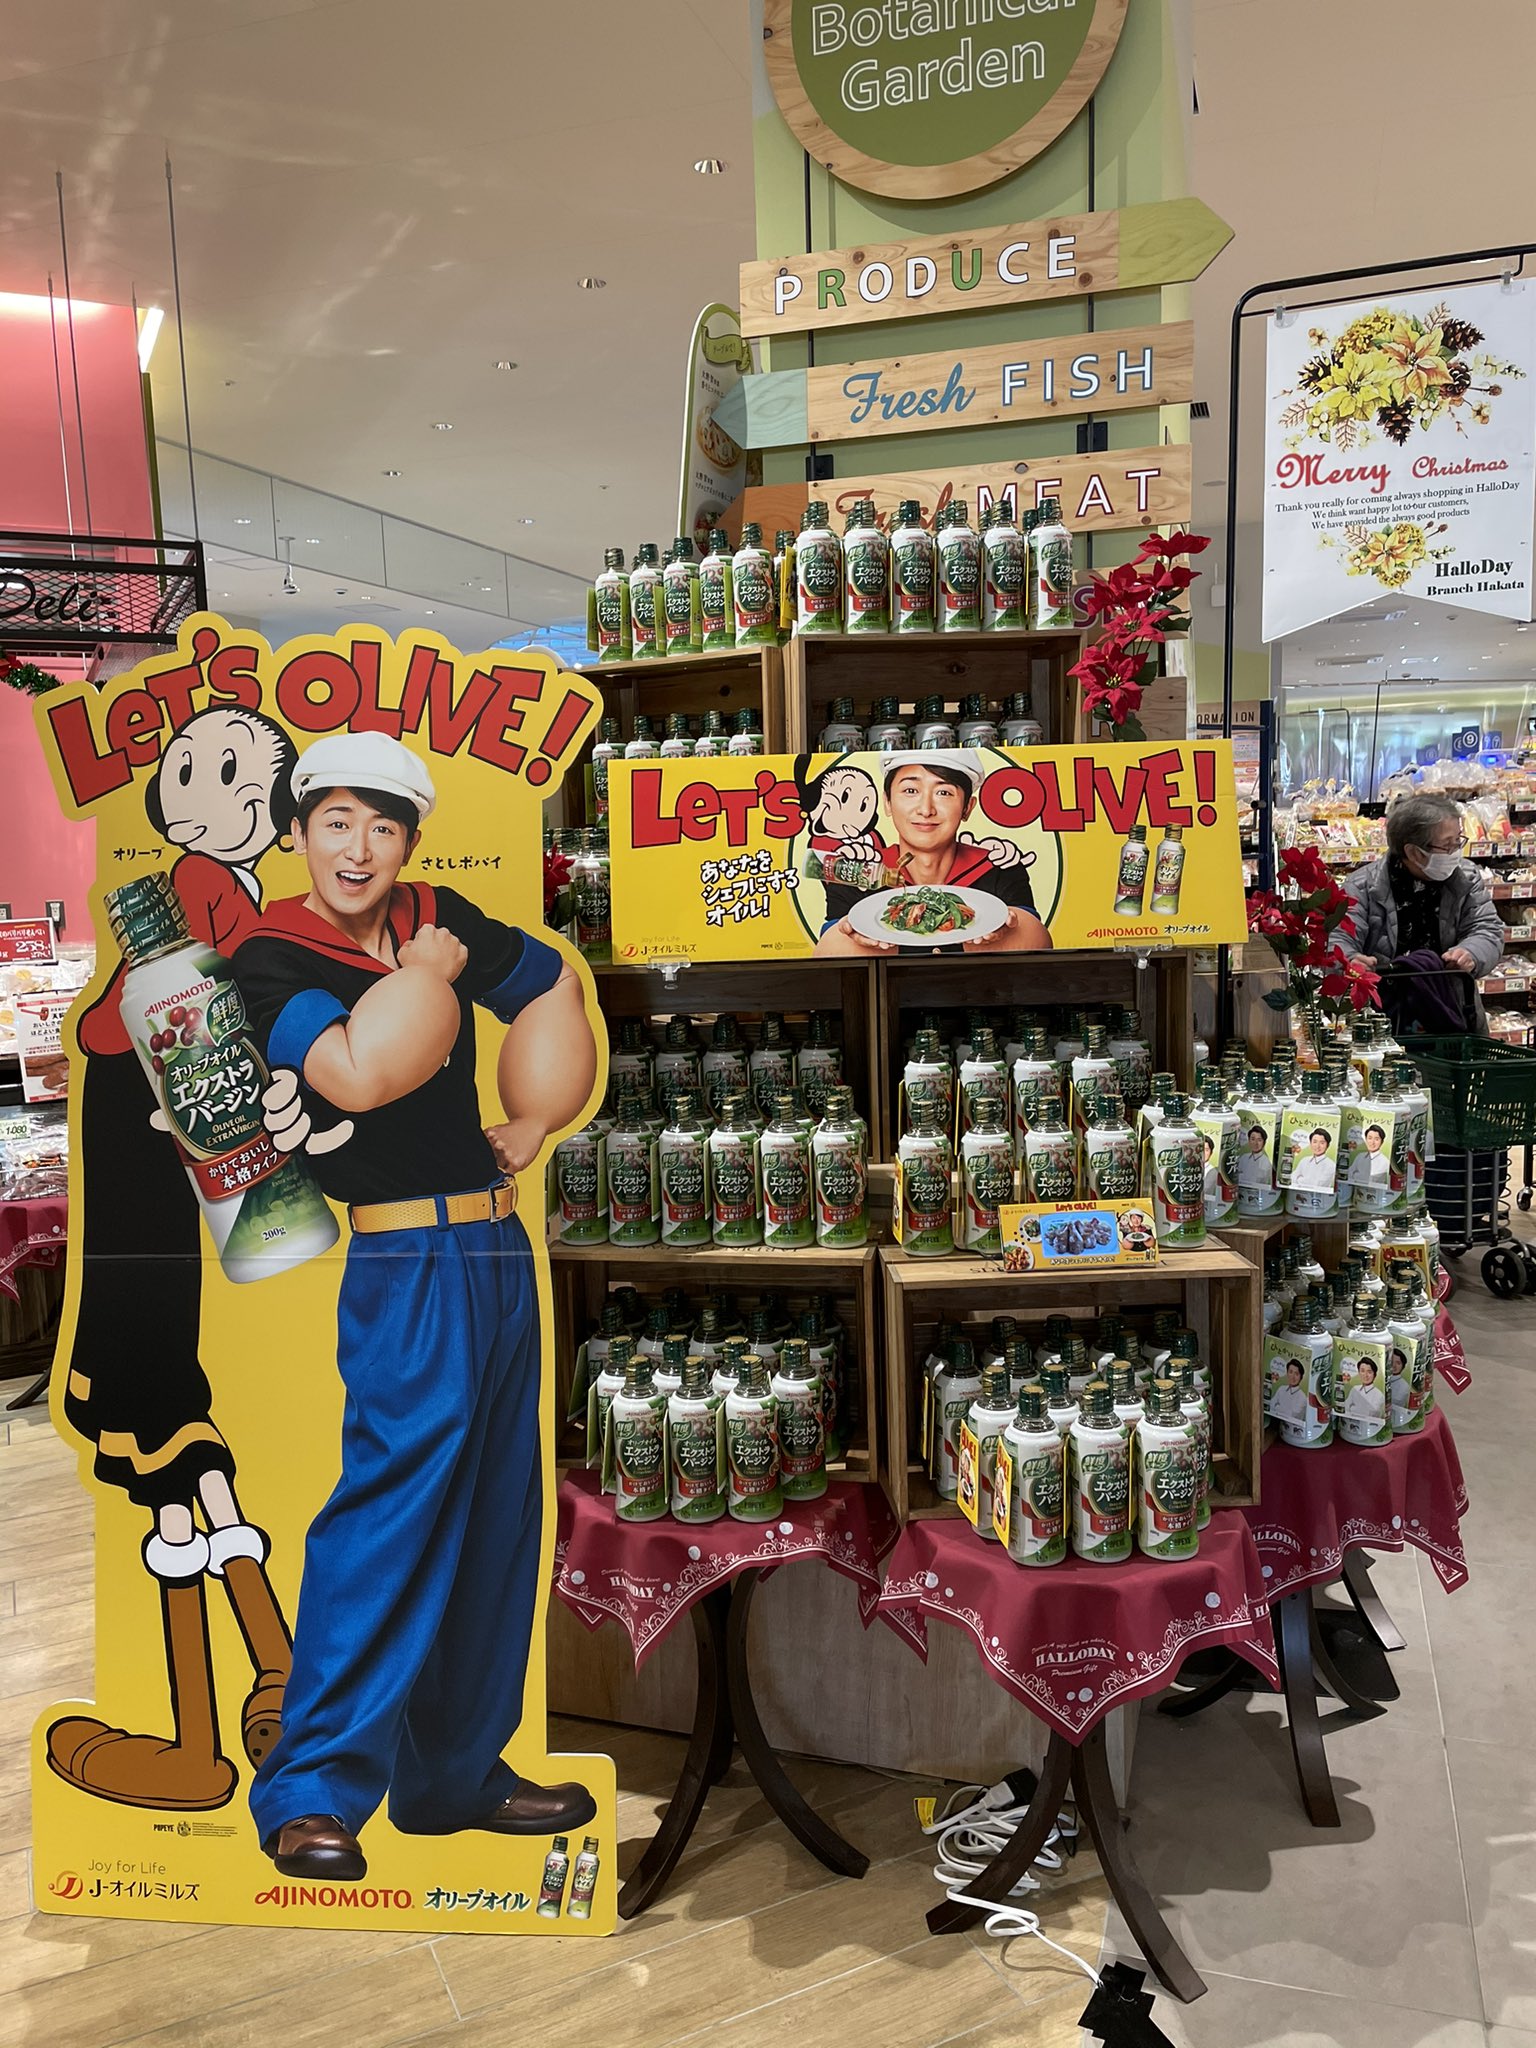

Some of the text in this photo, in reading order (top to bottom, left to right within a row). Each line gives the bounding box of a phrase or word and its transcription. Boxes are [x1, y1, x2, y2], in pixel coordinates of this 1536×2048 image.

[812, 0, 1077, 56] Botan
[841, 37, 1045, 112] Garden
[774, 235, 1077, 315] PRODUCE
[842, 347, 1154, 424] Fresh FISH
[1276, 452, 1509, 493] Merry Christmas
[1275, 481, 1520, 513] Thank you really for coming always shopping in HalloDay
[1313, 511, 1327, 519] We
[1328, 508, 1347, 518] think
[1349, 508, 1366, 516] want
[1367, 504, 1391, 515] happy
[1312, 521, 1325, 530] We
[1326, 519, 1343, 528] have
[1344, 516, 1377, 527] provided
[1378, 514, 1391, 524] the
[1416, 511, 1434, 522] good
[1434, 508, 1470, 519] products
[1435, 559, 1513, 578] HalloDay
[1427, 579, 1524, 596] Branch Hakata
[276, 640, 593, 787] OLIVE!
[1196, 711, 1255, 724] ORMION
[1466, 734, 1474, 745] 9
[978, 749, 1219, 834] OLIVE!
[113, 847, 165, 861] オリーブ
[421, 855, 502, 871] さとしポパイ
[701, 849, 772, 884] あなたを
[701, 868, 799, 905] シェフにする
[705, 894, 771, 927] オイル!
[1087, 926, 1158, 938] AJINOMOTO
[1164, 924, 1210, 935] オリーブオイル
[144, 980, 213, 1017] AJINOMOTO
[211, 991, 241, 1025] 鮮度
[171, 1044, 241, 1083] オリーブオイル
[173, 1061, 254, 1113] エクストラ
[188, 1082, 260, 1134] バージン
[1289, 1116, 1340, 1128] ひとかけレシピ
[1346, 1111, 1393, 1125] ひとかけレシピ
[564, 1175, 596, 1184] エクストラ
[614, 1176, 646, 1185] エクストラ
[669, 1175, 702, 1185] エクストラ
[717, 1175, 749, 1185] エクストラ
[770, 1176, 802, 1186] エクストラ
[823, 1176, 855, 1186] エクストラ
[977, 1179, 1010, 1189] エクストラ
[1037, 1177, 1072, 1187] エクストラ
[1100, 1175, 1133, 1186] エクストラ
[1168, 1173, 1201, 1184] エクストラ
[566, 1184, 596, 1193] バージン
[616, 1184, 646, 1194] バージン
[671, 1184, 702, 1194] バージン
[719, 1185, 748, 1194] バージン
[772, 1185, 802, 1195] バージン
[826, 1186, 855, 1195] バージン
[911, 1182, 945, 1192] エクストラ
[1039, 1186, 1071, 1196] バージン
[1102, 1184, 1133, 1195] バージン
[1171, 1183, 1201, 1194] バージン
[912, 1191, 945, 1201] バージン
[979, 1189, 1010, 1199] バージン
[263, 1226, 287, 1242] 200g
[1270, 1342, 1312, 1362] ひとかけレシピ
[1338, 1343, 1384, 1359] ひとかけレシピ
[783, 1426, 817, 1436] エクストラ
[785, 1436, 816, 1446] バージン
[624, 1445, 660, 1456] エクストラ
[680, 1446, 715, 1457] エクストラ
[735, 1444, 770, 1456] エクストラ
[626, 1455, 659, 1466] バージン
[682, 1456, 715, 1467] バージン
[736, 1455, 770, 1466] バージン
[1094, 1479, 1128, 1492] エクストラ
[1157, 1476, 1195, 1489] エクストラ
[1096, 1490, 1127, 1502] バージン
[1159, 1488, 1195, 1500] バージン
[1035, 1647, 1116, 1667] HALLODAY
[1083, 1664, 1098, 1674] Gift
[153, 1824, 174, 1833] POPEYE
[88, 1859, 166, 1875] Joy for Life
[256, 1886, 412, 1909] AJINOMOTO
[425, 1887, 530, 1911] オリーブオイル
